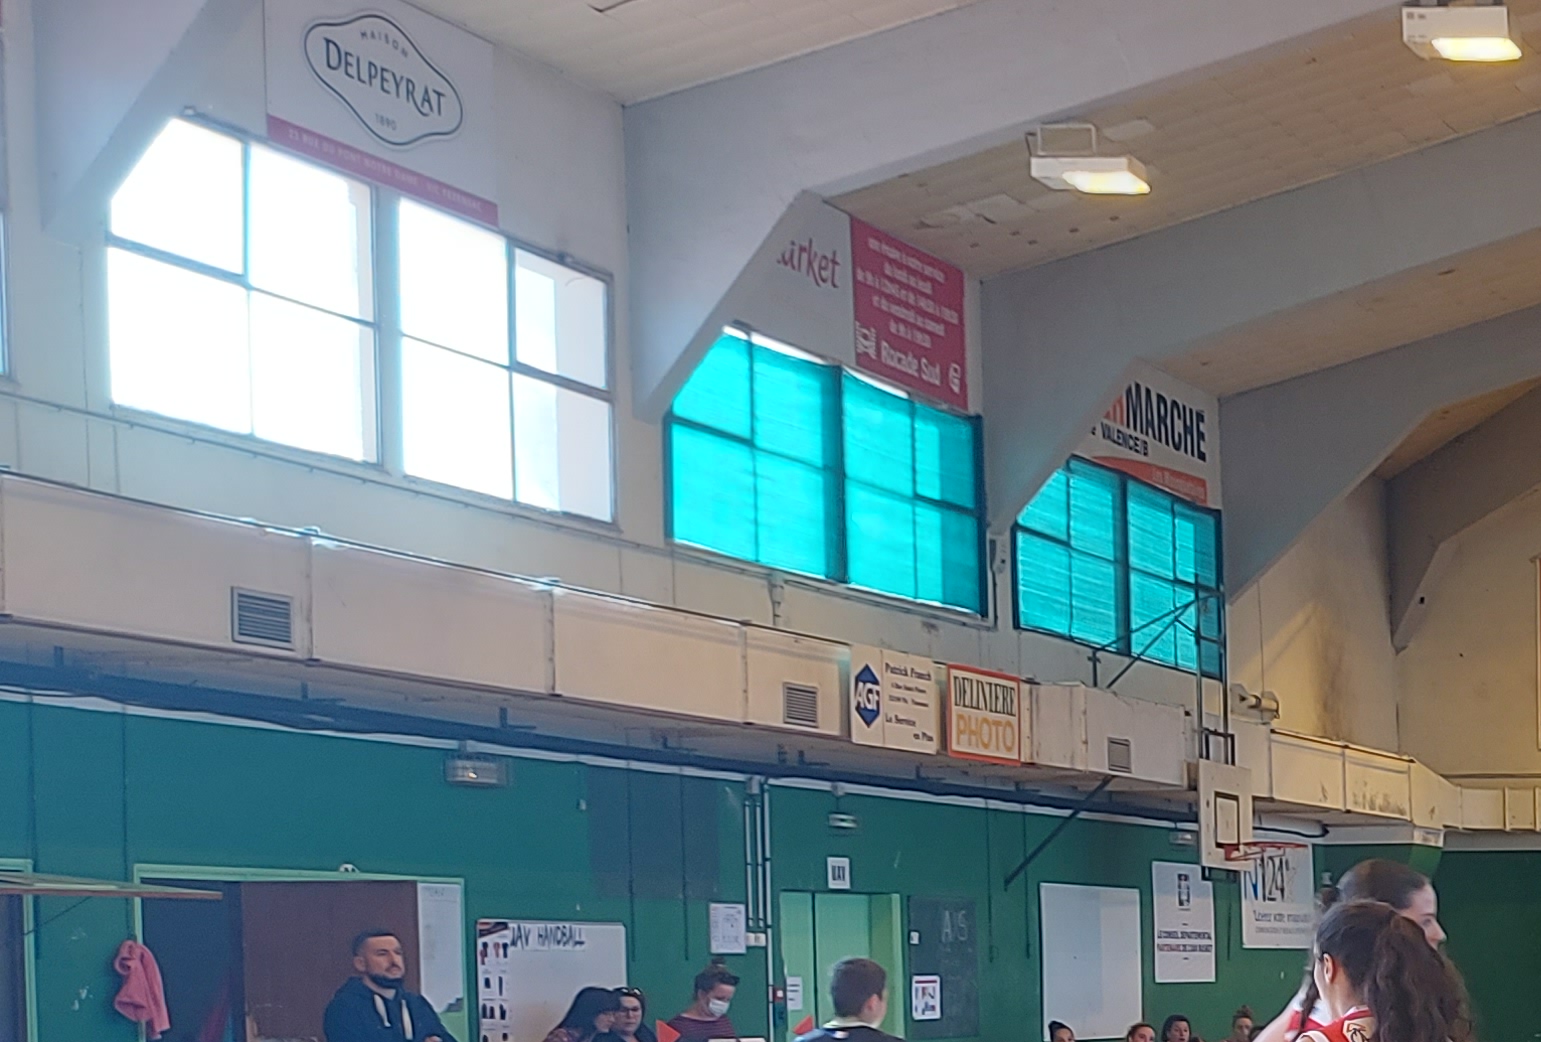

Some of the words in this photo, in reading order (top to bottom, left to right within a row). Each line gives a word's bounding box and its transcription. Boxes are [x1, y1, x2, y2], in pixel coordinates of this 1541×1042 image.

[360, 31, 408, 58] MAISON
[323, 37, 446, 117] DELPEYRAT
[375, 113, 397, 131] 1890
[777, 237, 840, 288] arket
[855, 681, 880, 712] AGF
[953, 675, 1016, 717] DELINIERE
[956, 713, 1015, 753] PHOTO
